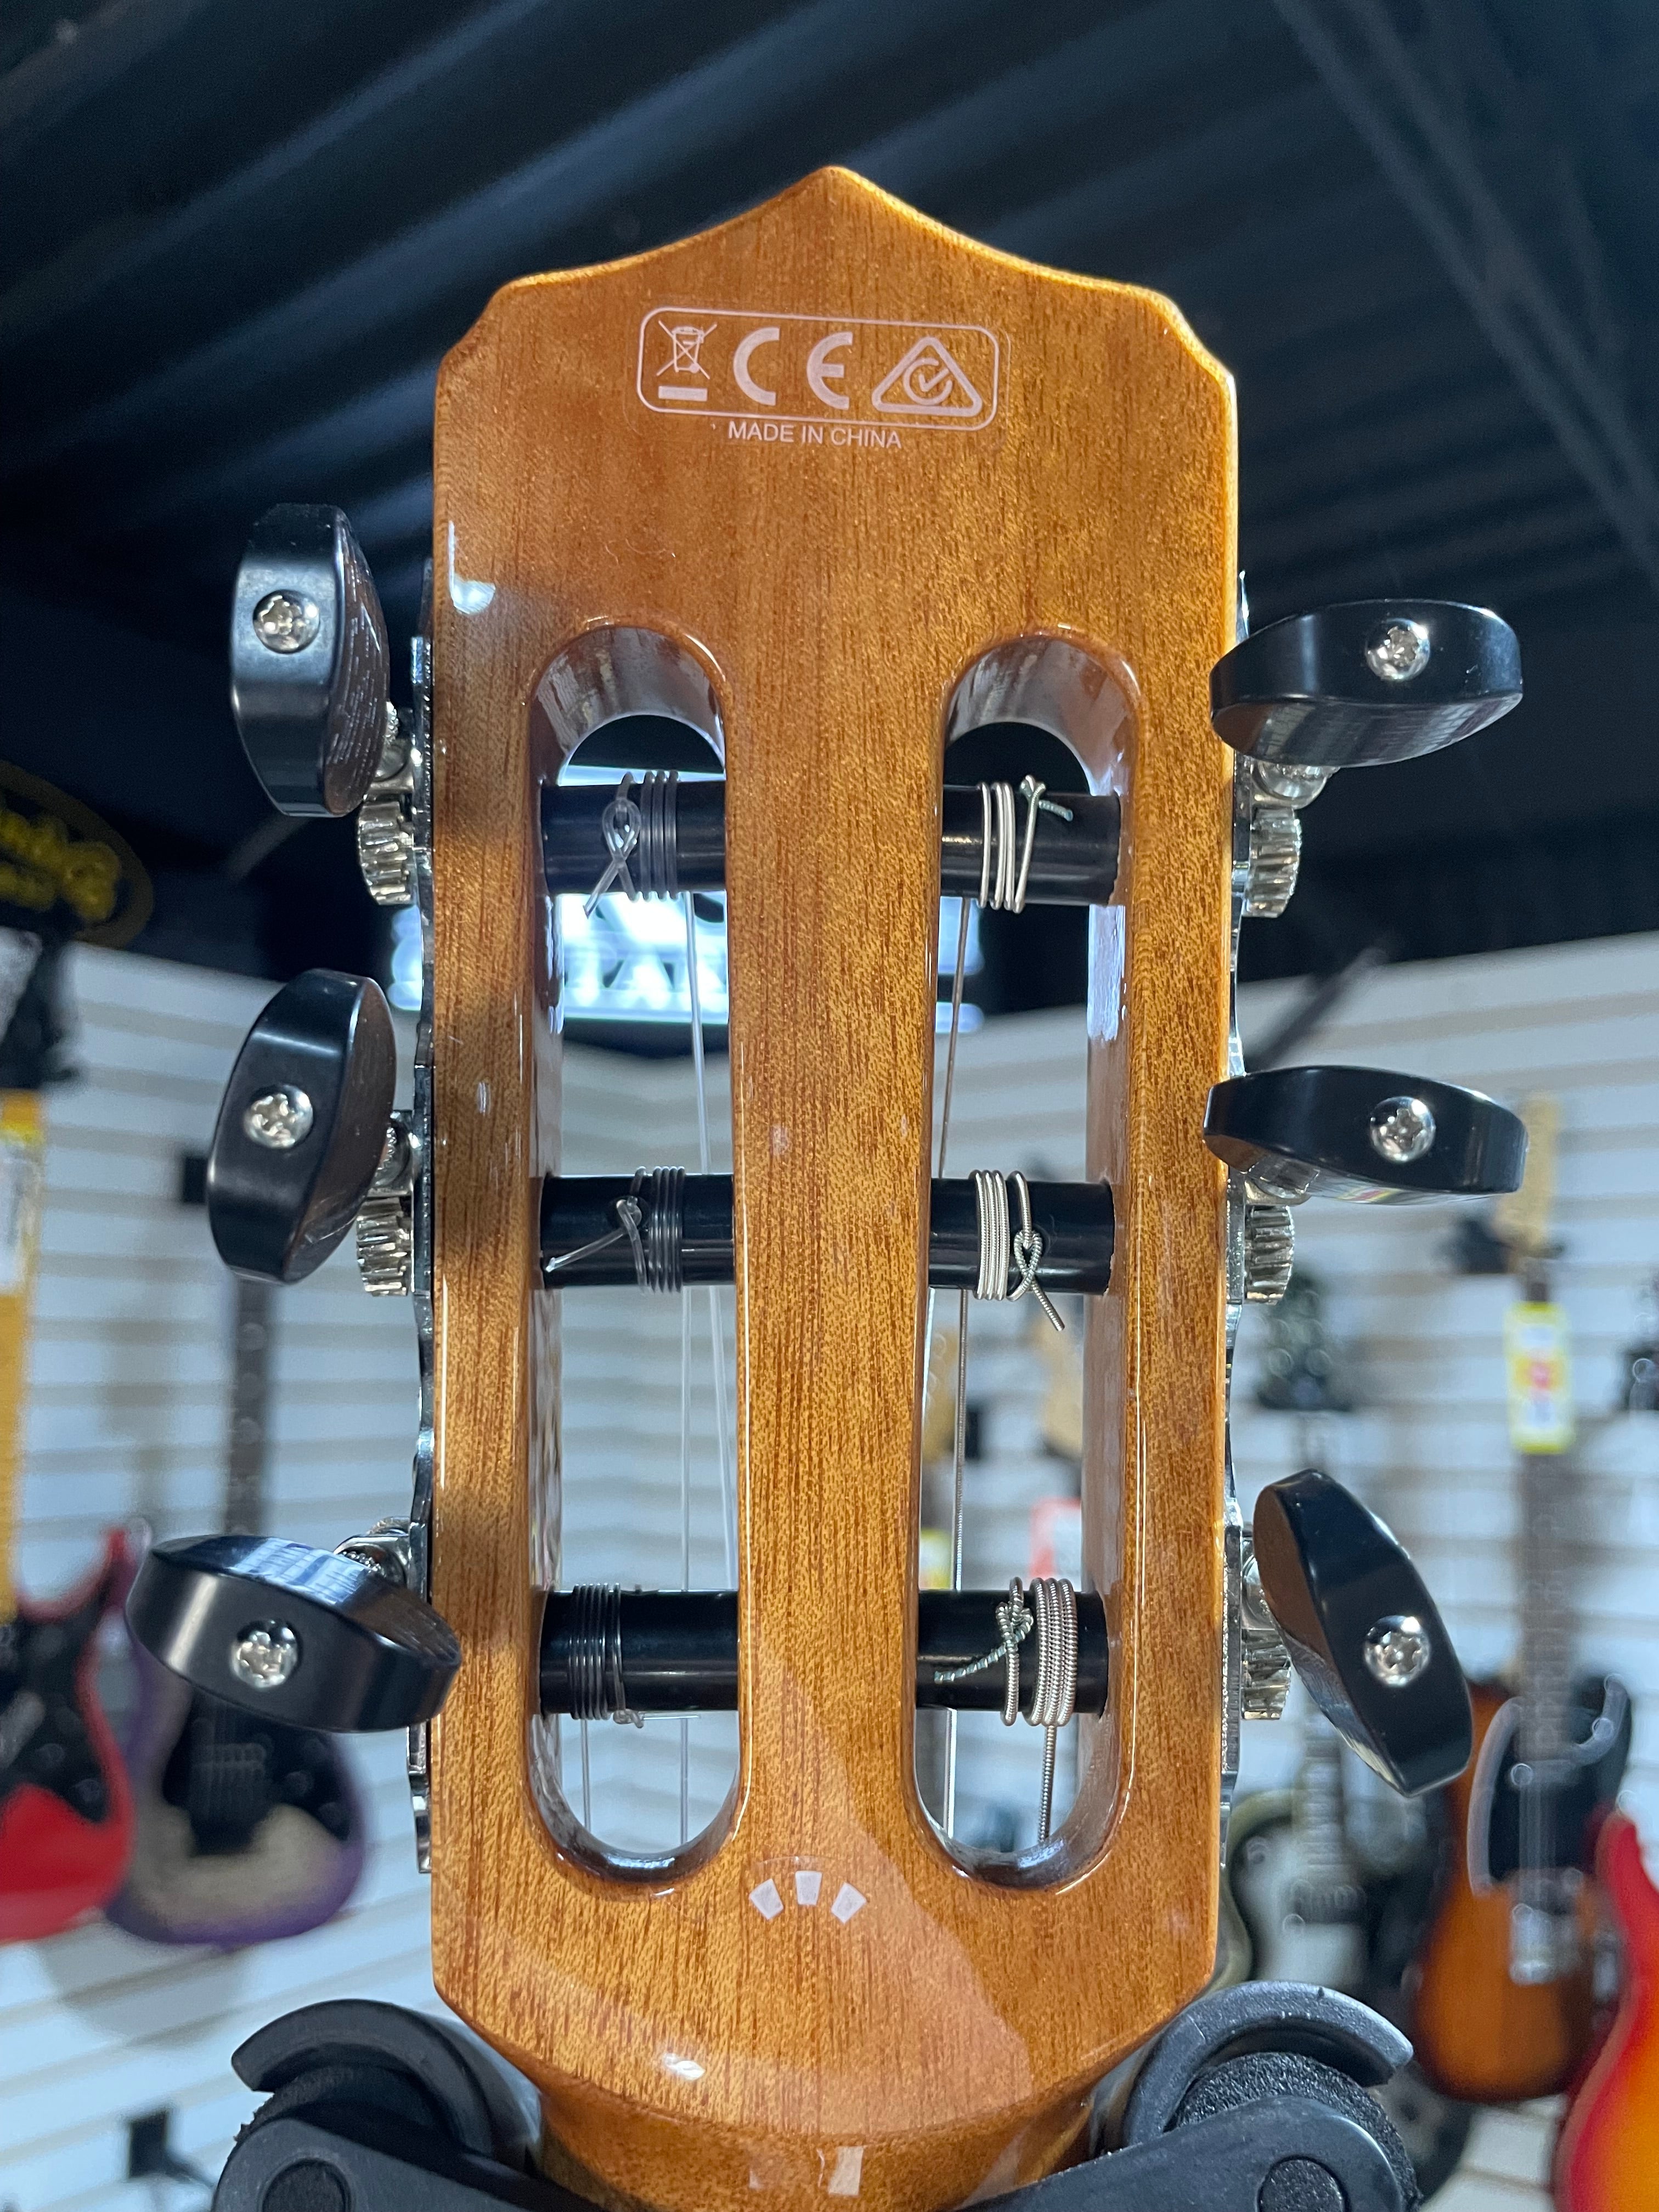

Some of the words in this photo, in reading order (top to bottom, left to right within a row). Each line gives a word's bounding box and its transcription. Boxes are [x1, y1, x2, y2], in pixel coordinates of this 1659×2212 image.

[733, 327, 853, 409] CE
[727, 421, 794, 442] MADE
[802, 425, 823, 444] IN
[830, 427, 902, 448] CHINA
